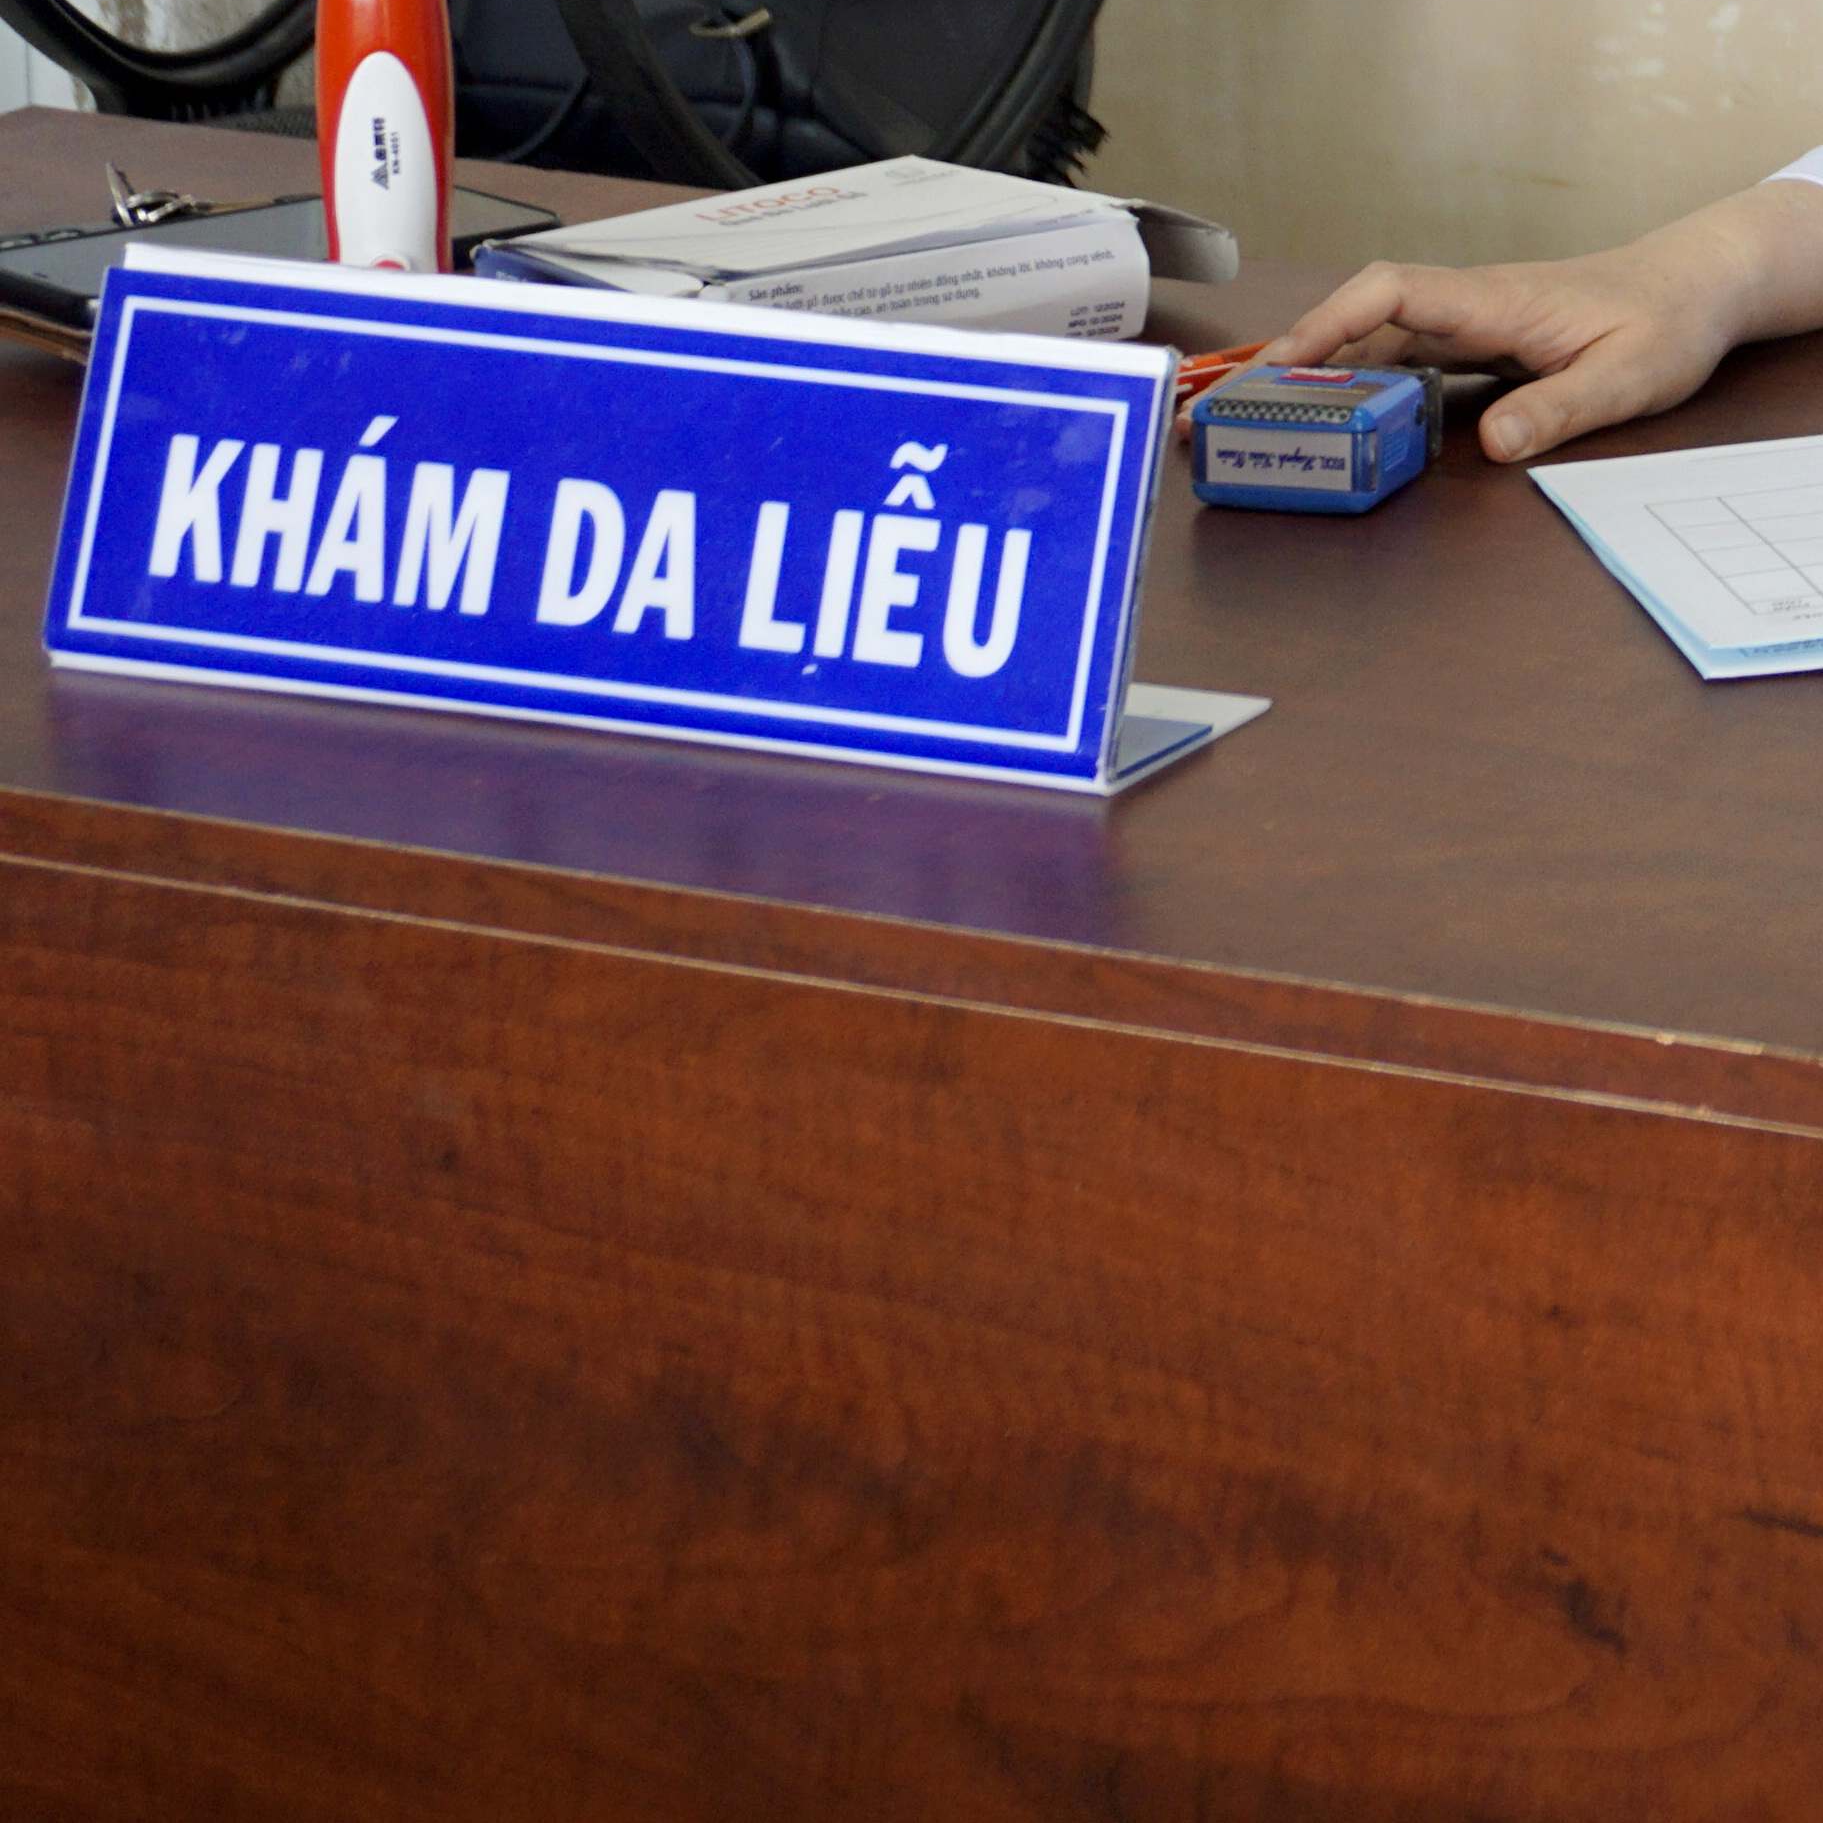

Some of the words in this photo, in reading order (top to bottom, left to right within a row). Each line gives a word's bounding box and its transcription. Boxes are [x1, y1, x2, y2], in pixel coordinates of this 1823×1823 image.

[694, 186, 841, 222] LITOCO
[148, 414, 511, 617] KHÁM
[535, 477, 697, 641] DA
[738, 441, 1033, 679] LIỄU
